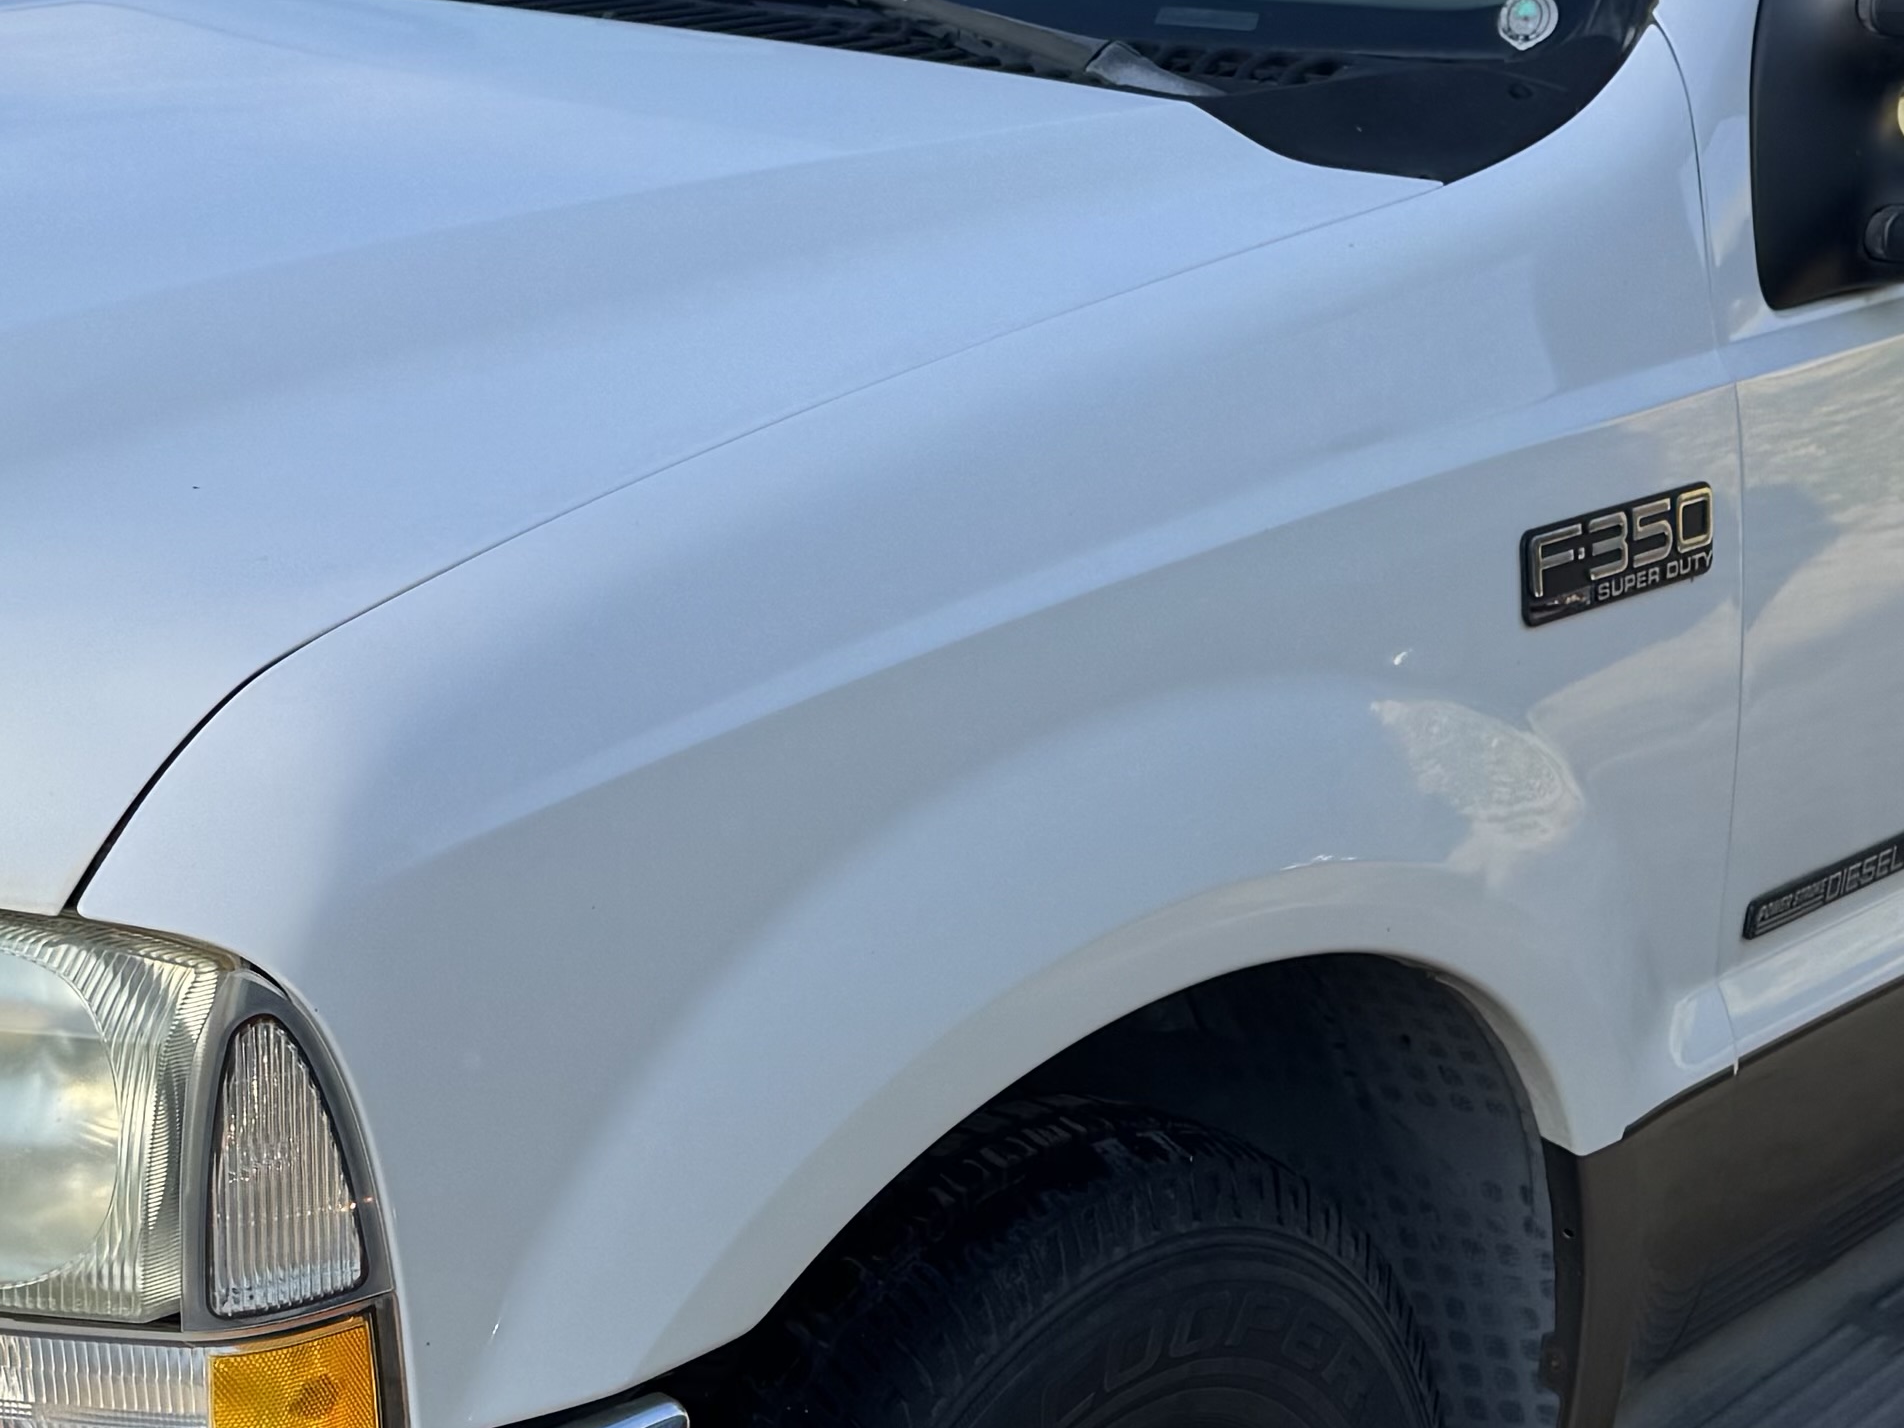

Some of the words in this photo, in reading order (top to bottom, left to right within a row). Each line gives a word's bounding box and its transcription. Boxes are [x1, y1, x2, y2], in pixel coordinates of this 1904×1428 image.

[1598, 567, 1660, 601] SUPER
[1666, 550, 1713, 580] DUTY
[1827, 845, 1904, 901] DIESEL
